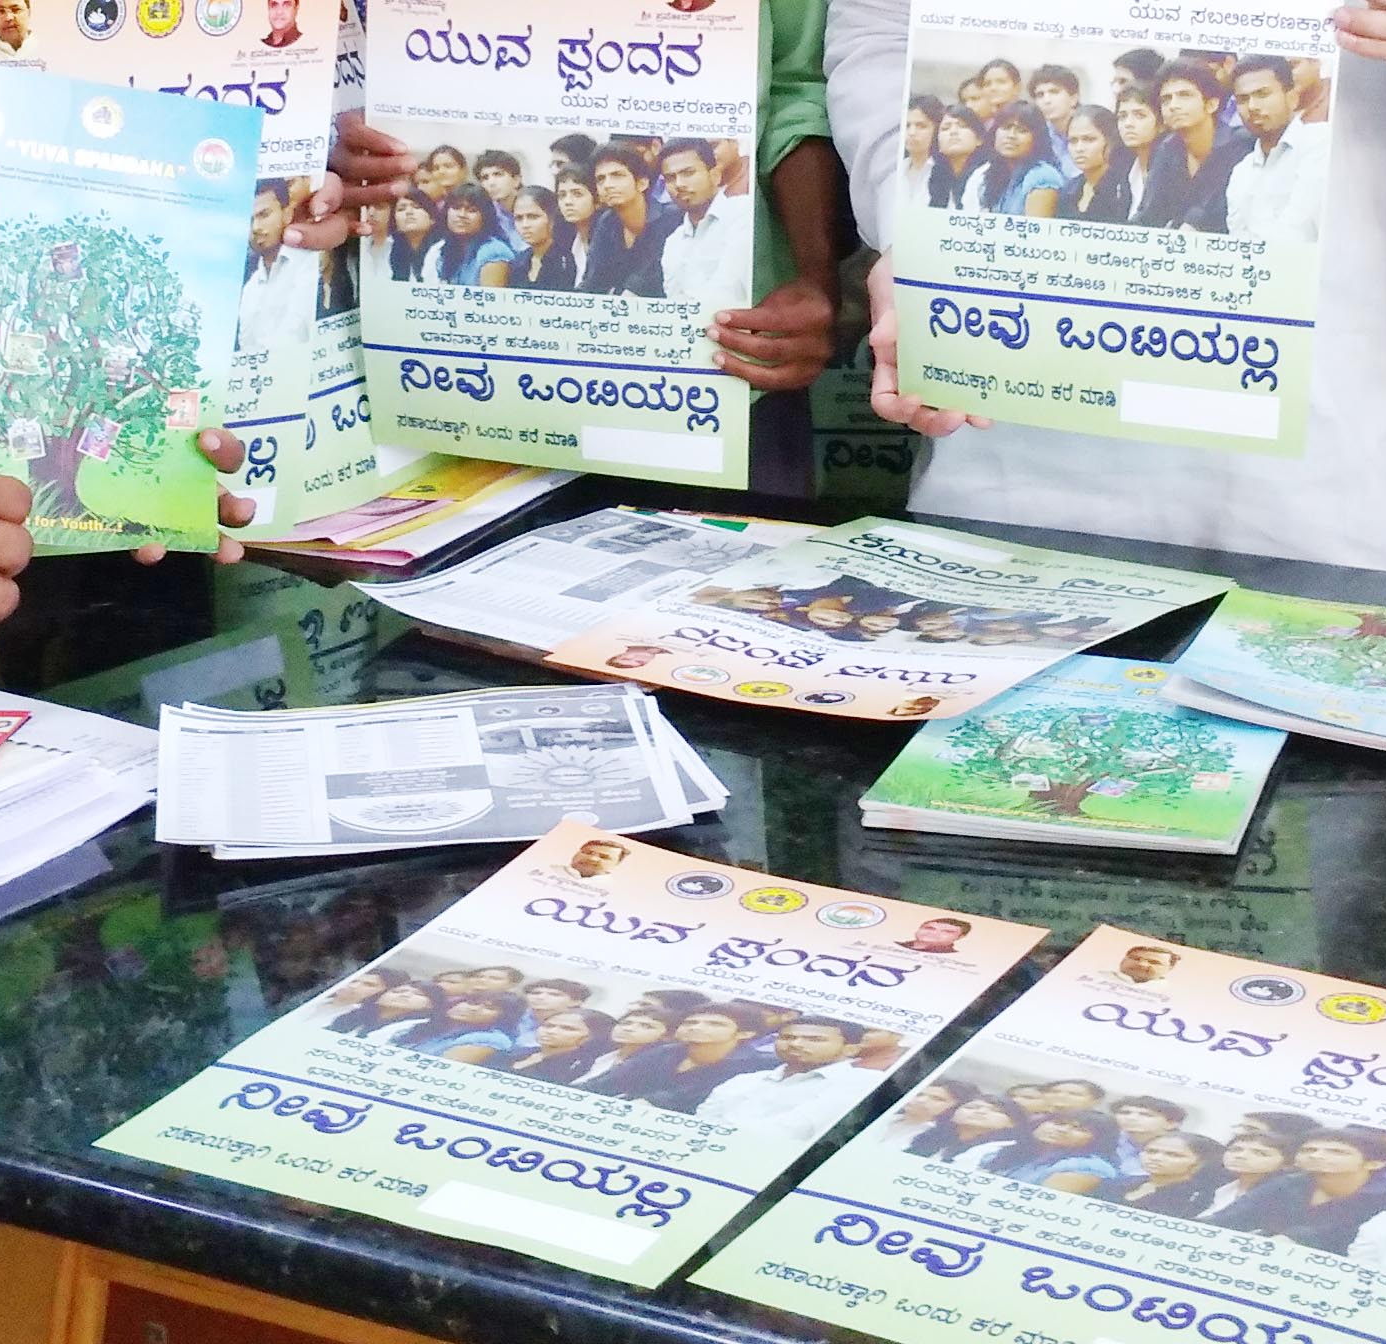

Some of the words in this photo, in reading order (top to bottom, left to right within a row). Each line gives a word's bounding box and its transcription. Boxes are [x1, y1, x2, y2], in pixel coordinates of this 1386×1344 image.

[403, 19, 531, 70] ಯುವ
[556, 28, 703, 92] ಸ್ಪಂದನ
[926, 296, 1030, 348] ನೀವು
[1055, 318, 1278, 389] ಒಂಟಿಯಲ್ಲ
[399, 358, 494, 401] ನೀವು
[517, 374, 718, 431] ಒಂಟಿಯಲ್ಲ
[524, 901, 706, 943] ಯುವ
[706, 936, 923, 987] ಸ್ಪಂದನ
[1081, 1004, 1288, 1055] ಯುವ
[223, 1081, 371, 1131] ನೀವು
[394, 1124, 689, 1223] ಒಂಟಿಯಲ್ಲ
[817, 1213, 984, 1274] ನೀವು
